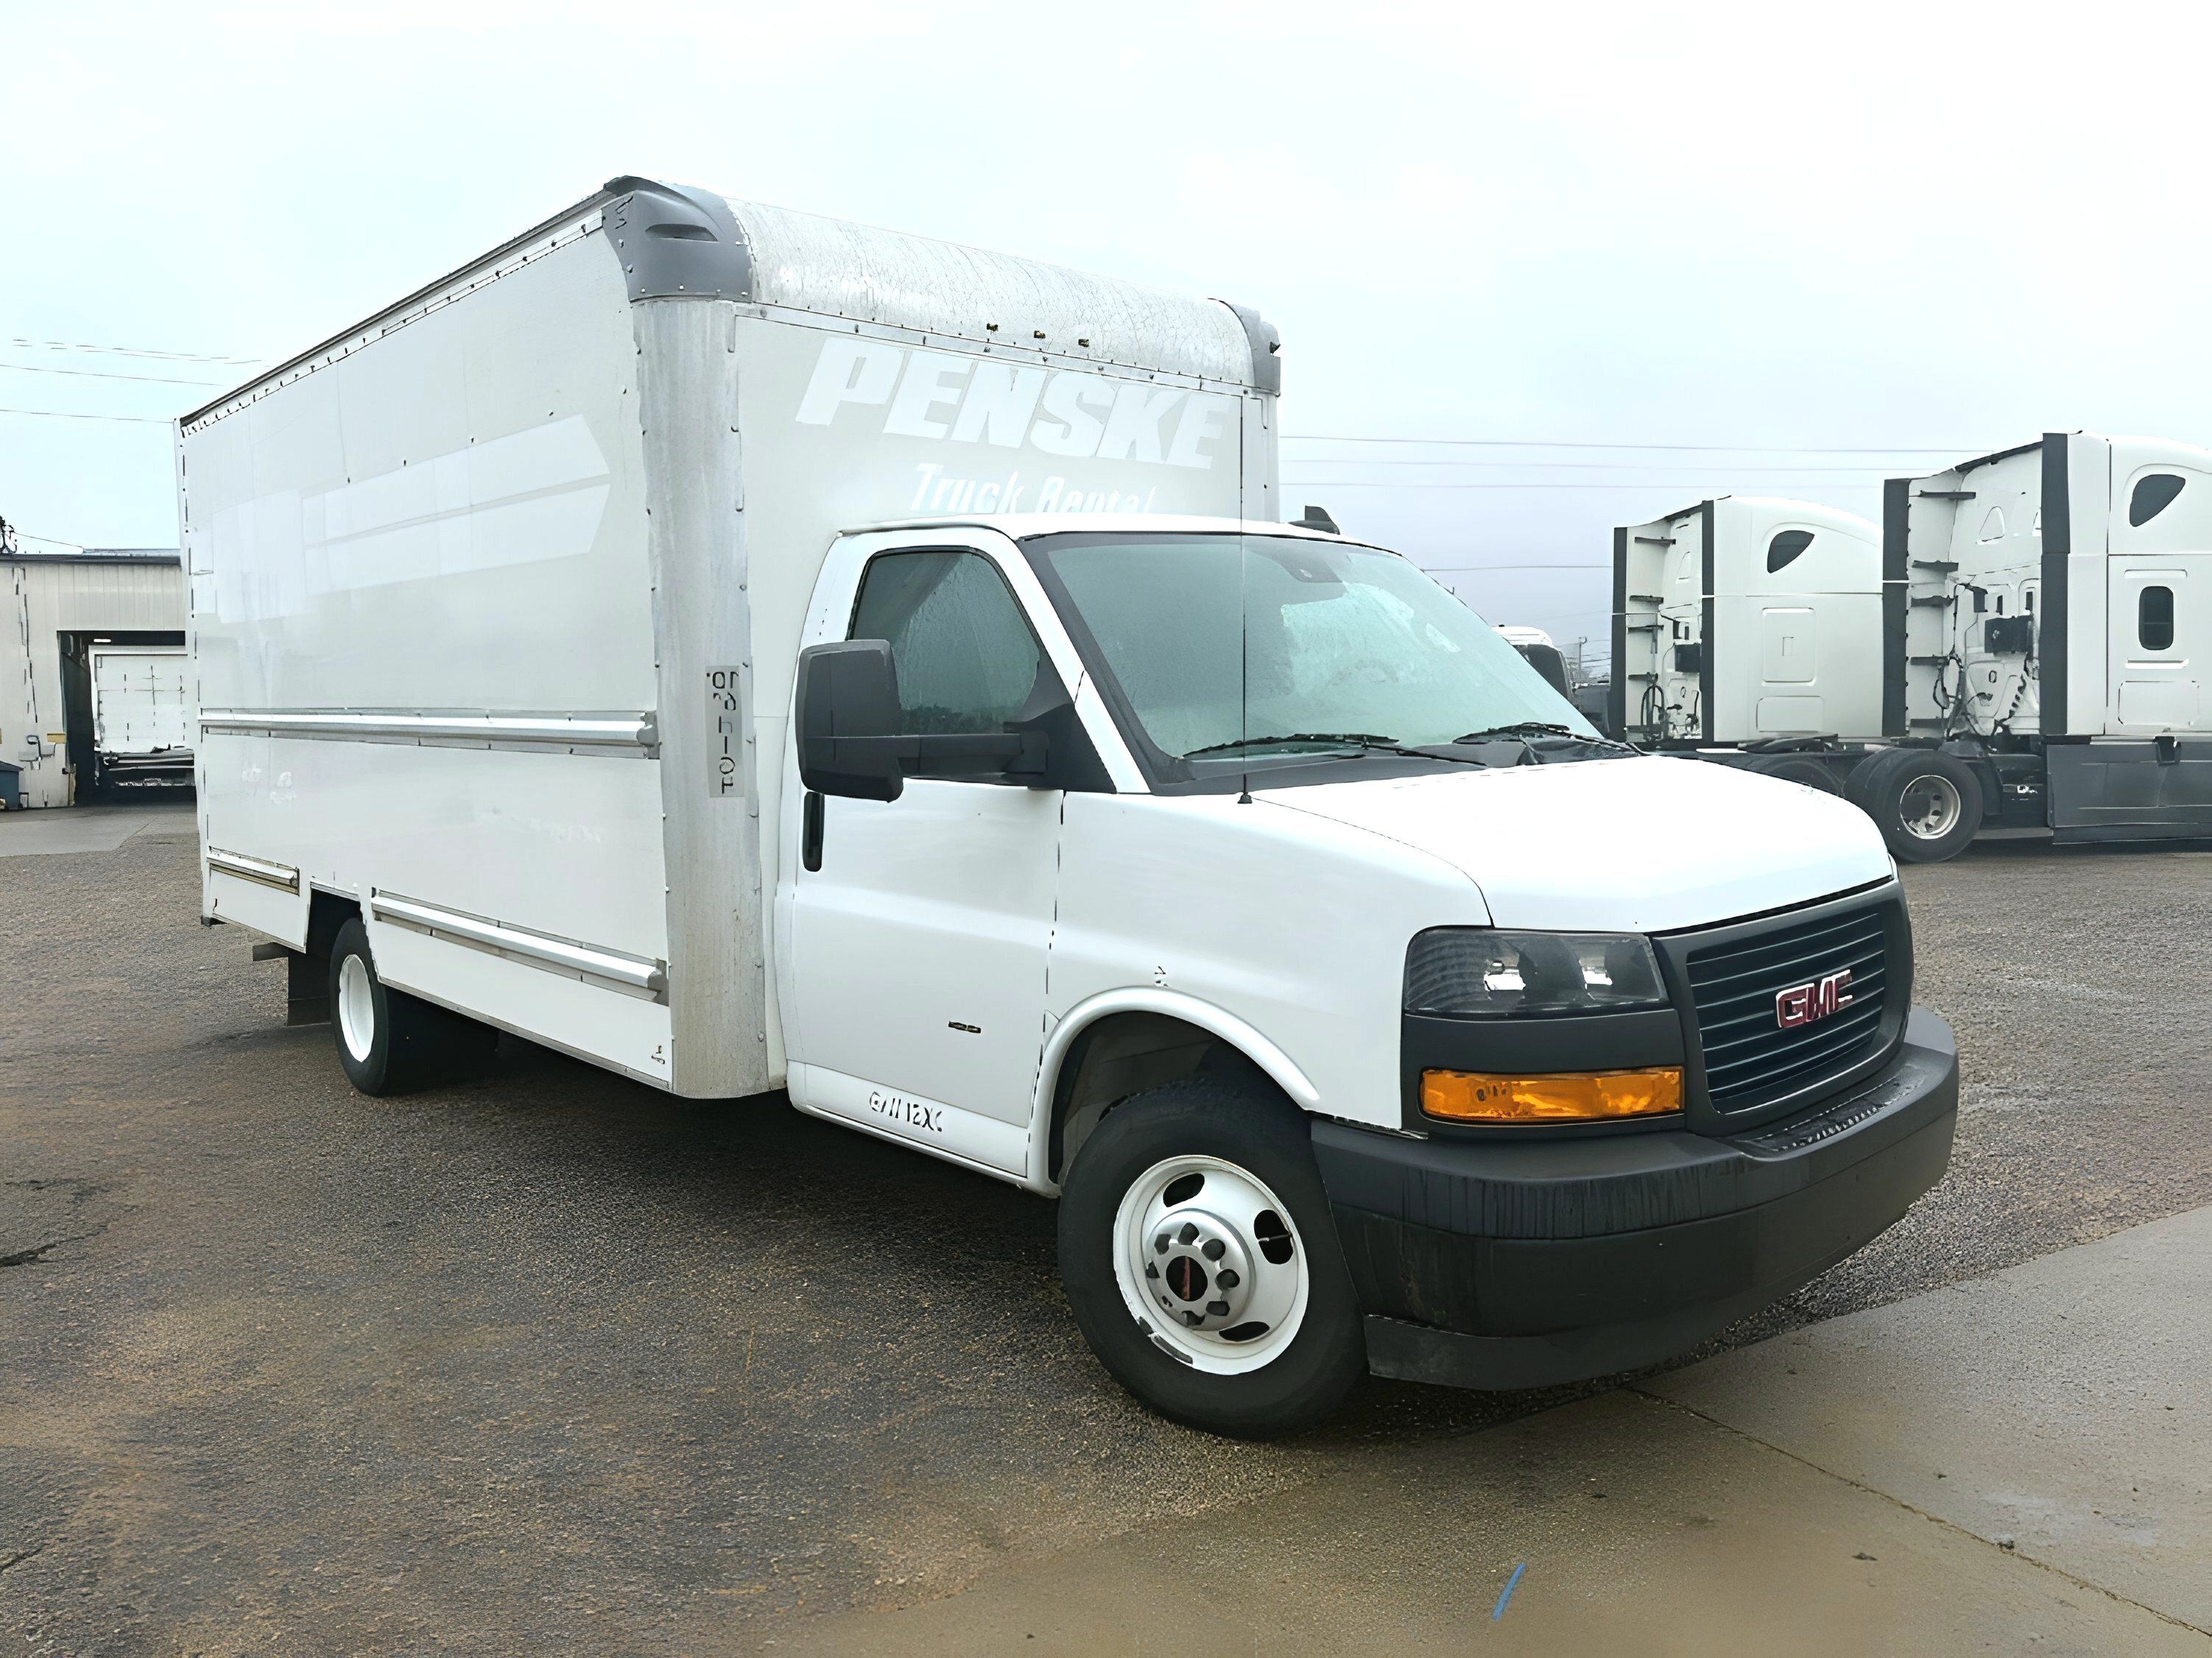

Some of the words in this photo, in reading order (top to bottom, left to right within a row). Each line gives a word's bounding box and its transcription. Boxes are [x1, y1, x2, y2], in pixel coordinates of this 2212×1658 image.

[795, 336, 1233, 469] PENSKE
[911, 462, 1026, 514] Truck
[1775, 969, 1853, 1029] GMC
